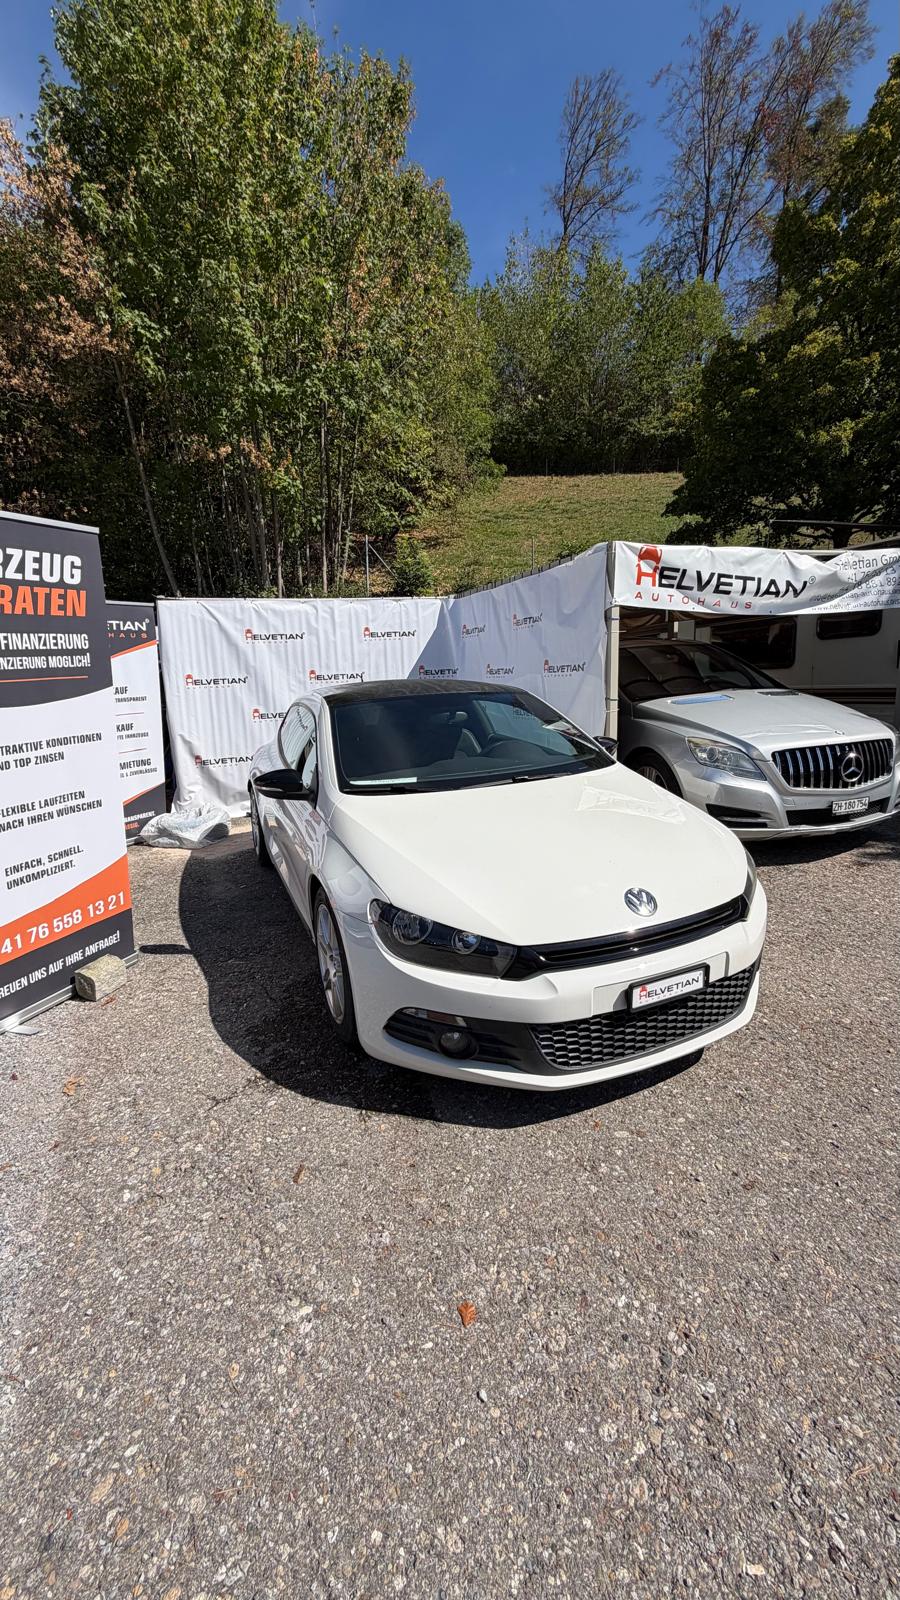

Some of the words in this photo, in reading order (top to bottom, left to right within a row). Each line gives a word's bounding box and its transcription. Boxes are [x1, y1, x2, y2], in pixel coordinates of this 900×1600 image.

[0, 547, 82, 585] ZEUG
[636, 560, 808, 598] HELVETIAN
[0, 584, 87, 617] RATEN
[634, 591, 753, 609] AUTOHAUS
[0, 633, 89, 651] FINANZIERUNG
[245, 631, 304, 641] HELVETIAN
[363, 629, 415, 639] HELVETIAN
[185, 677, 246, 687] HELVETIAN
[309, 672, 363, 681] HELVETIAN
[113, 686, 128, 695] AUF
[116, 723, 134, 732] KAUF
[0, 740, 44, 756] TRAKTIVE
[45, 732, 102, 749] KONDITIONEN
[13, 757, 32, 769] TOP
[34, 751, 65, 766] ZINSEN
[119, 758, 151, 770] MIETUNG
[39, 790, 86, 809] LAUFZEITEN
[0, 818, 25, 833] NACH
[27, 810, 54, 826] IHREN
[56, 799, 103, 818] WÜNSCHEN
[4, 857, 46, 877] EINFACH,
[47, 845, 84, 864] SCHNELL.
[6, 859, 76, 890] UNKOMPLIZIERT.
[27, 923, 49, 944] 76
[53, 908, 83, 934] 558
[87, 900, 105, 918] 13
[108, 891, 125, 911] 21
[29, 967, 47, 984] UNS
[48, 958, 64, 976] AUF
[65, 951, 84, 968] IHRE
[84, 930, 121, 955] ANFRAGE!
[639, 976, 700, 1000] HELVETIAN
